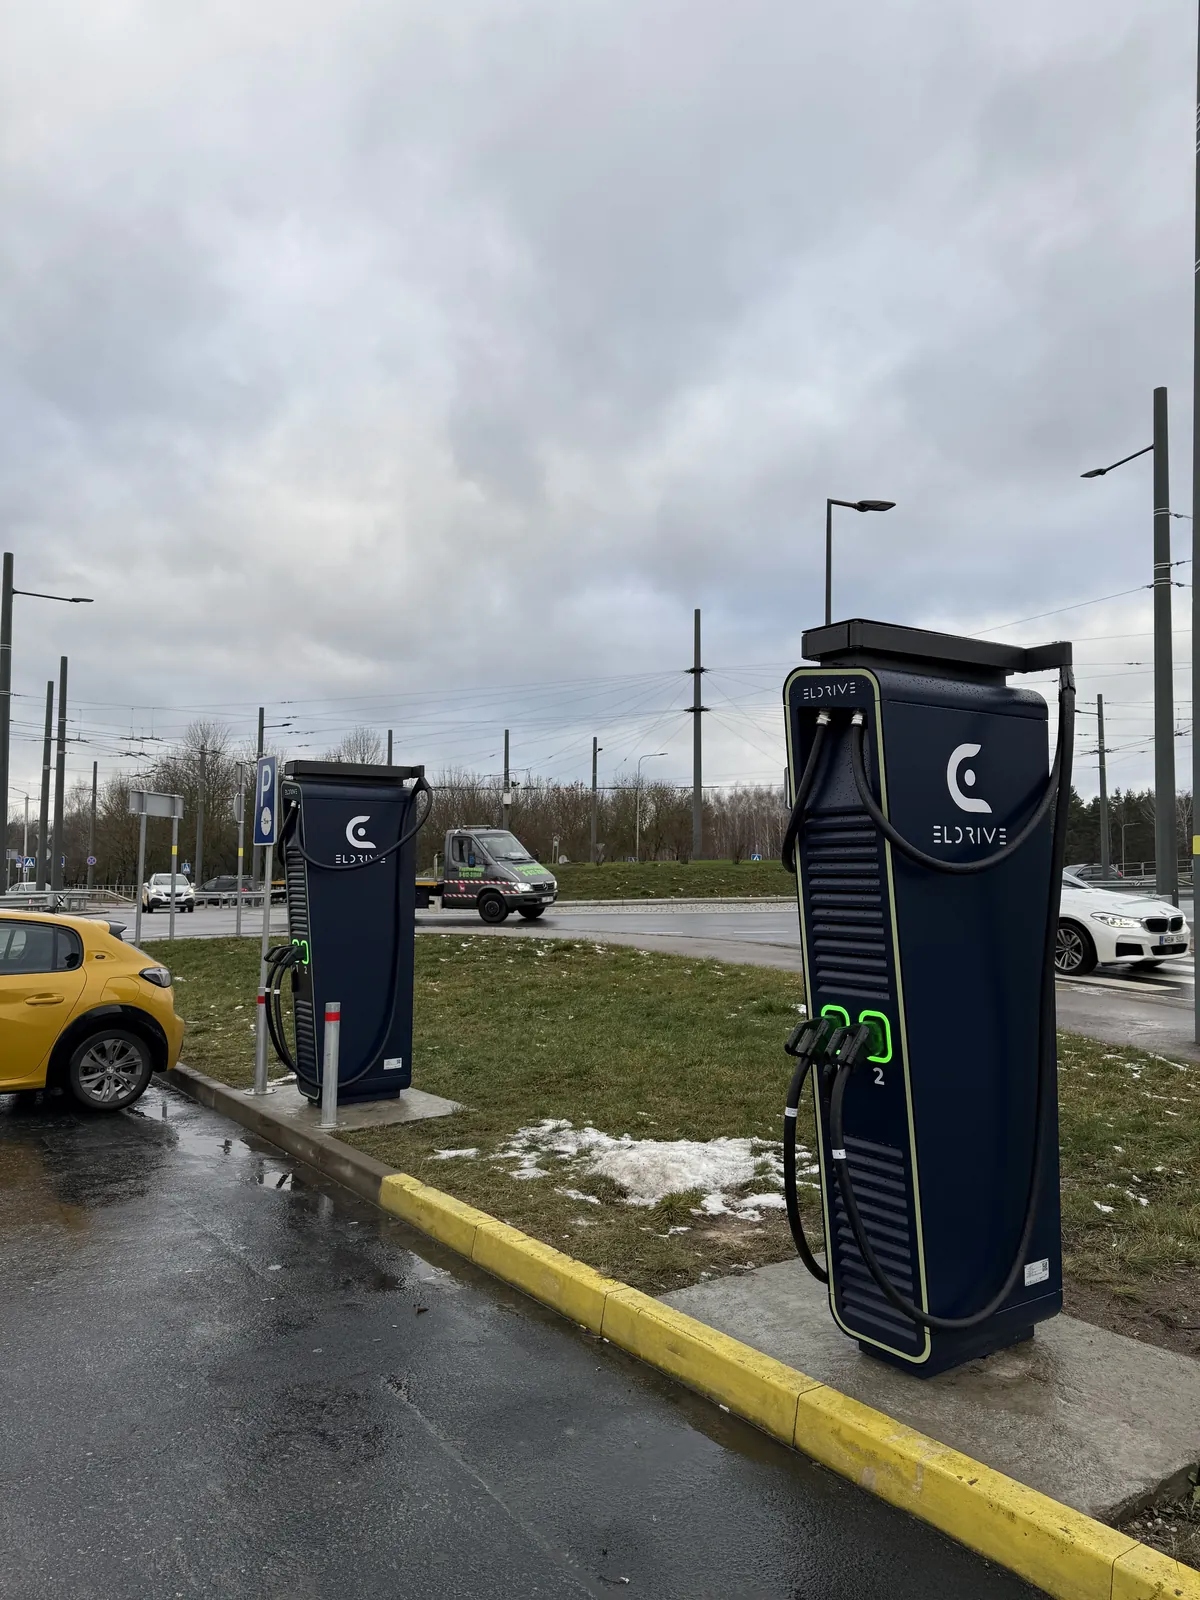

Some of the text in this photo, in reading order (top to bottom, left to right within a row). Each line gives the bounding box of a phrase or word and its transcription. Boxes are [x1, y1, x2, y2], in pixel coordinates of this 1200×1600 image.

[803, 682, 856, 700] ELDRIVE
[260, 764, 272, 807] P
[933, 825, 1007, 846] ELDRIVE
[872, 1067, 885, 1086] 2
